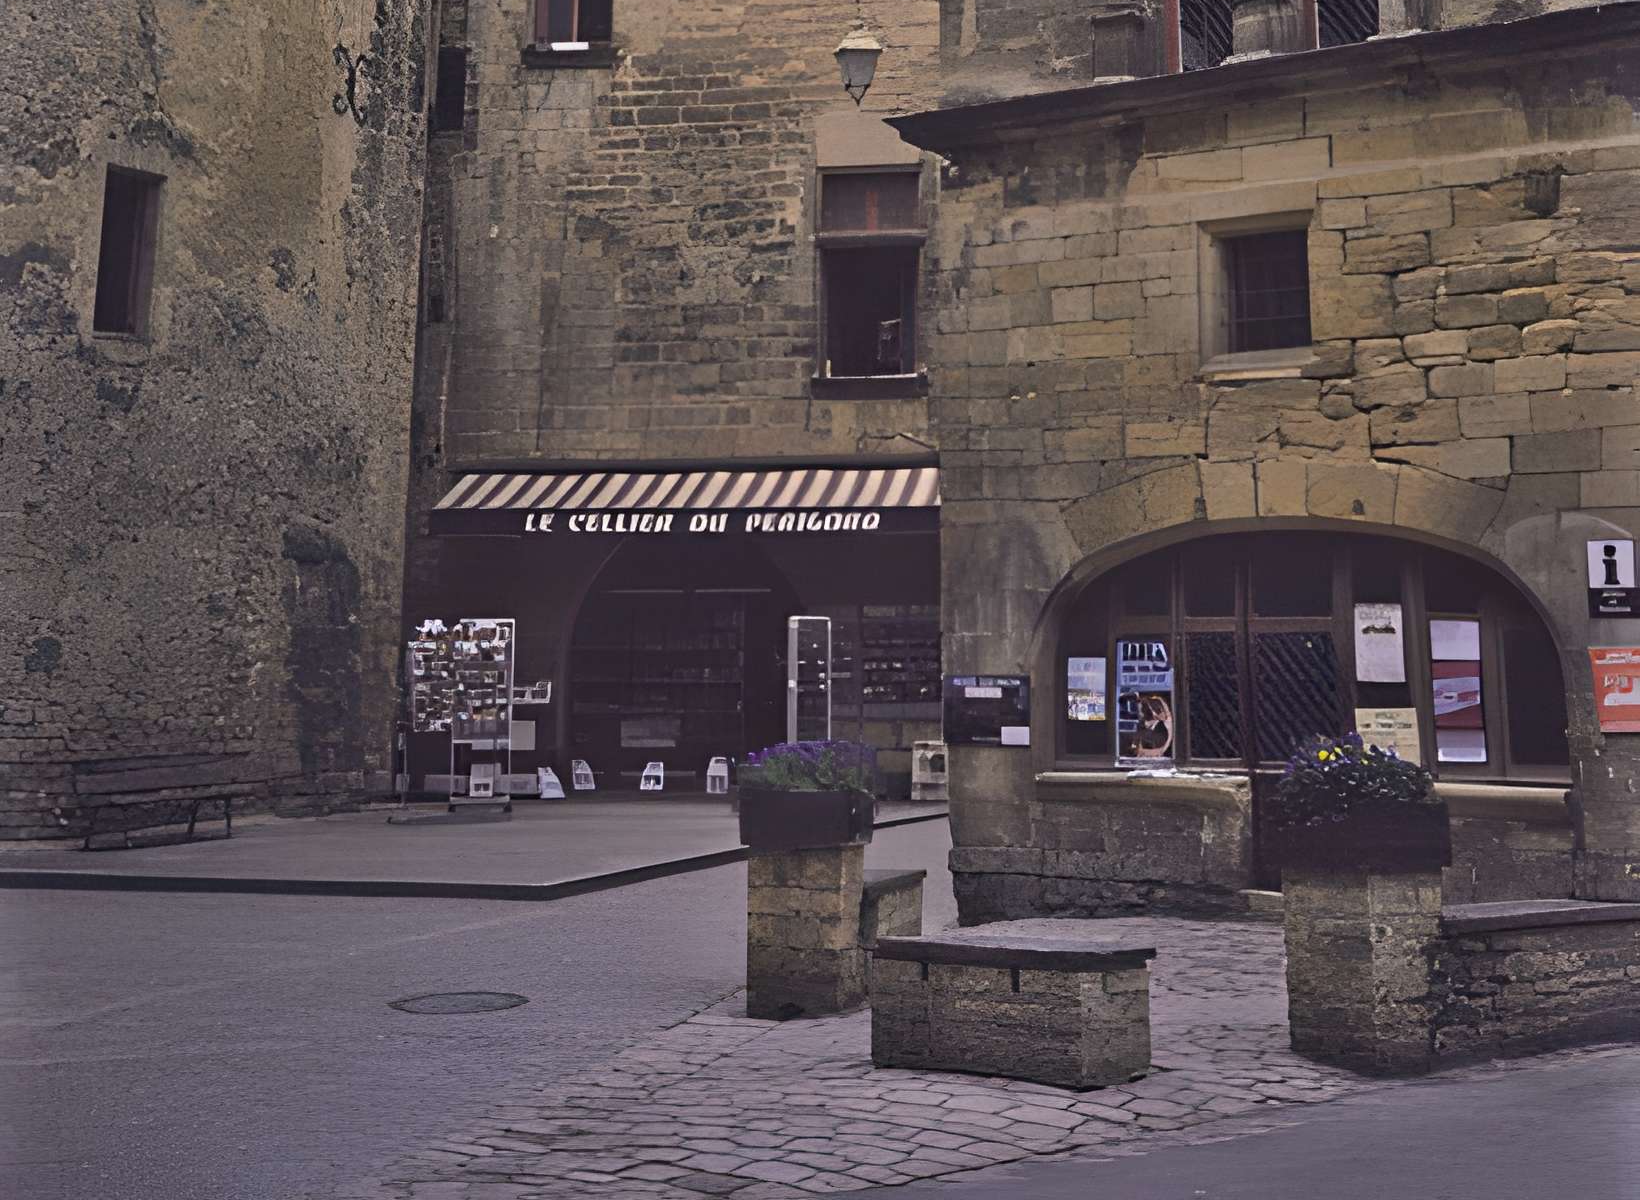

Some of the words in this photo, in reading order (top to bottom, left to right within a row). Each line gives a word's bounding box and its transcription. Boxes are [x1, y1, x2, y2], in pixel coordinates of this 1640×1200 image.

[525, 513, 555, 532] LE
[568, 513, 674, 533] CELLIER
[689, 513, 728, 533] DU
